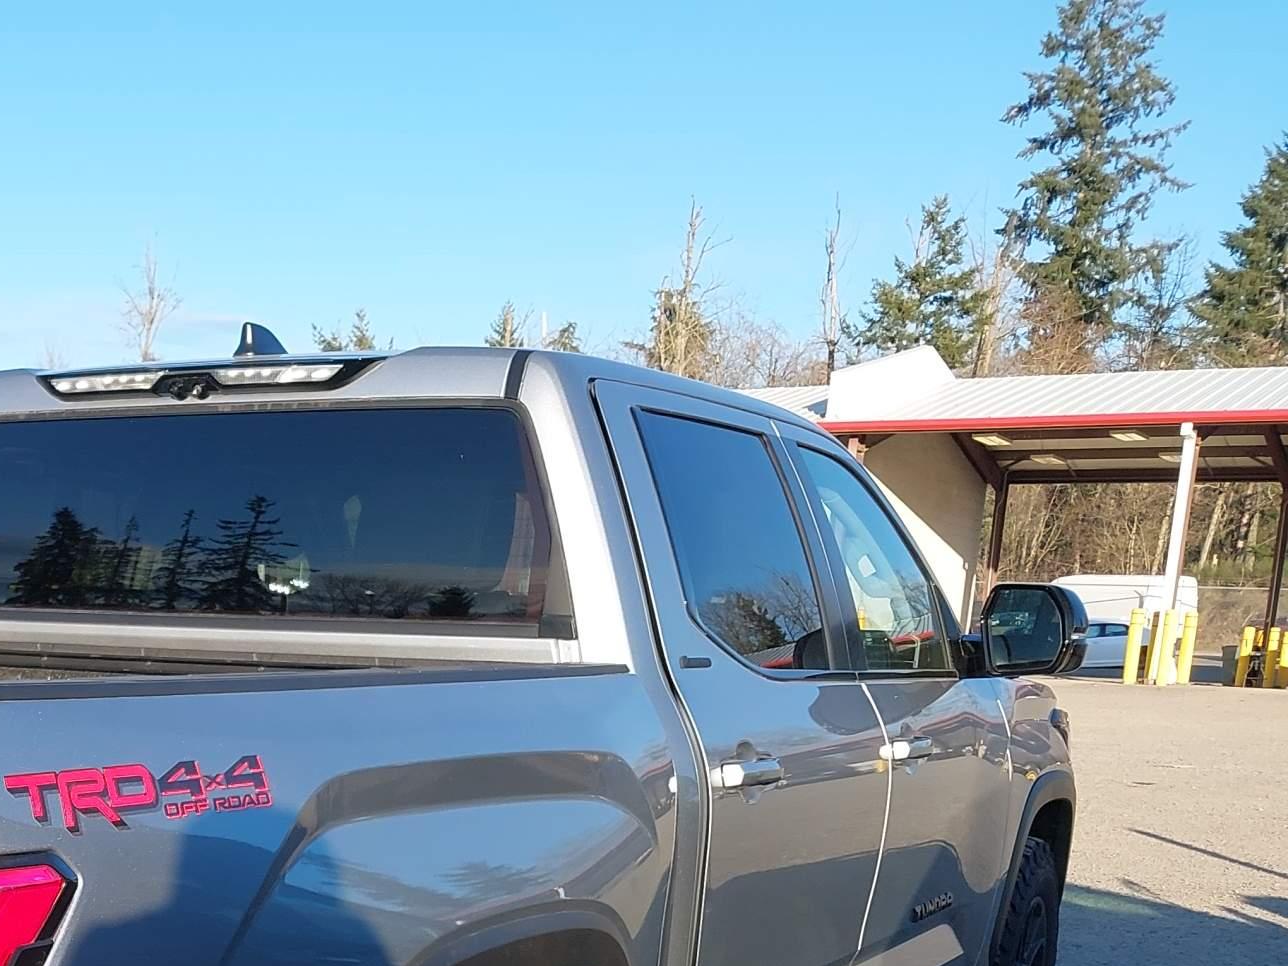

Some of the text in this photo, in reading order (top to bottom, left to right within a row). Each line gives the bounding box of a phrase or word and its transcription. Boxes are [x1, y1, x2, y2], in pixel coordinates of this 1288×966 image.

[3, 755, 272, 836] TRD 4x4
[163, 791, 273, 821] OFF ROAD
